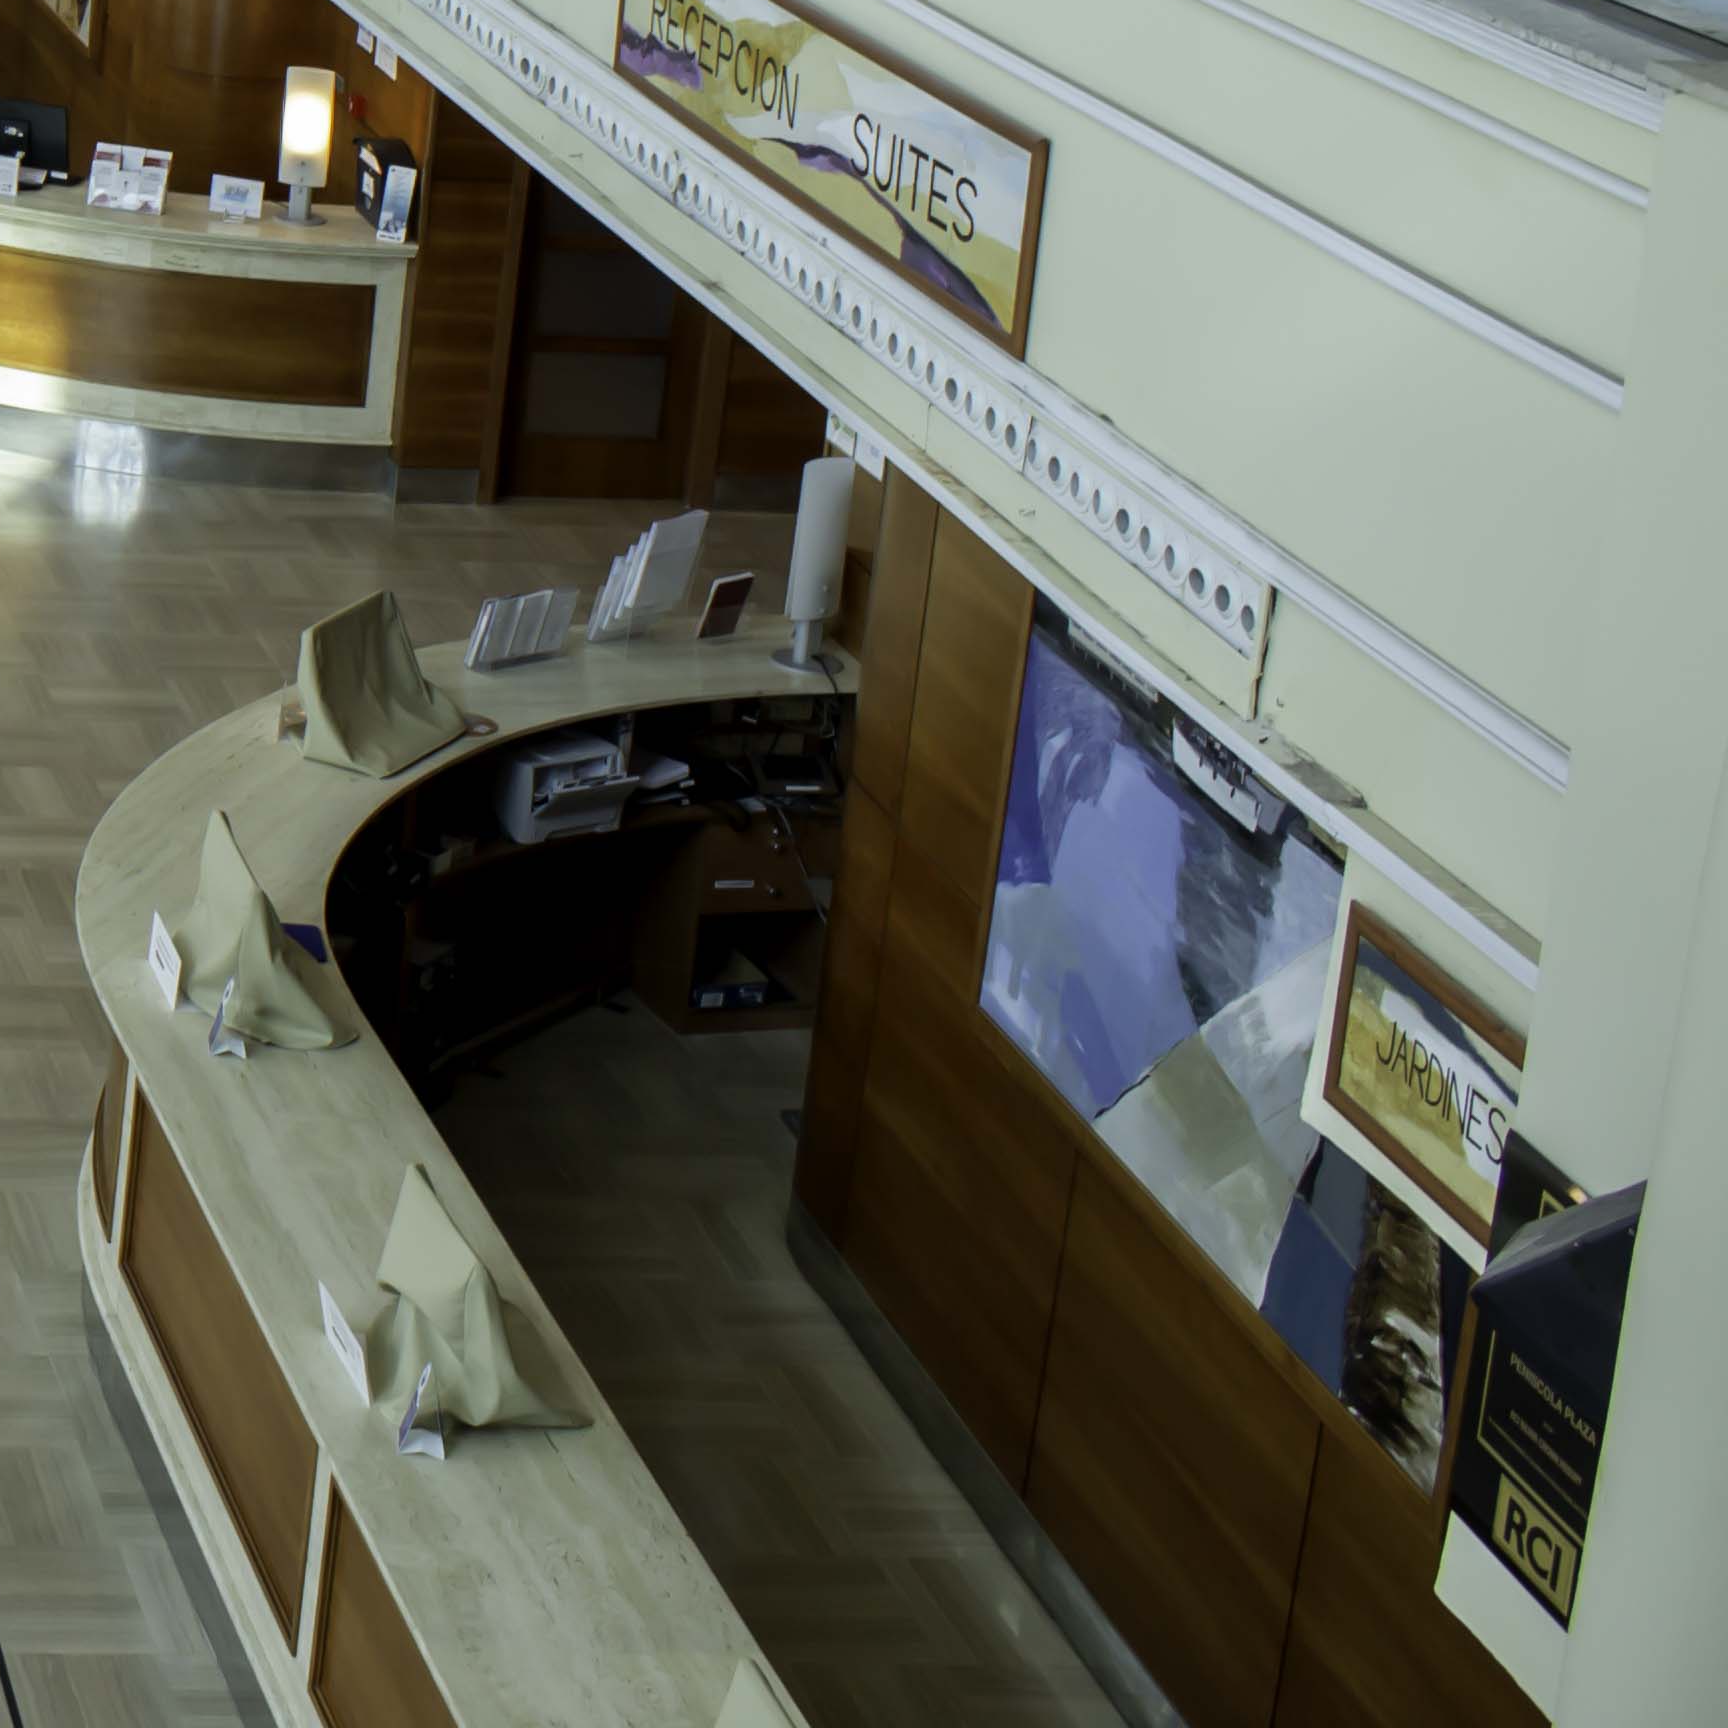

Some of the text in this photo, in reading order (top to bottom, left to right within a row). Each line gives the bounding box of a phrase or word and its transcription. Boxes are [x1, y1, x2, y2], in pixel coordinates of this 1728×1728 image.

[849, 113, 979, 243] SUITES
[1375, 1021, 1507, 1165] JARDINES
[1503, 1495, 1562, 1593] RCI
